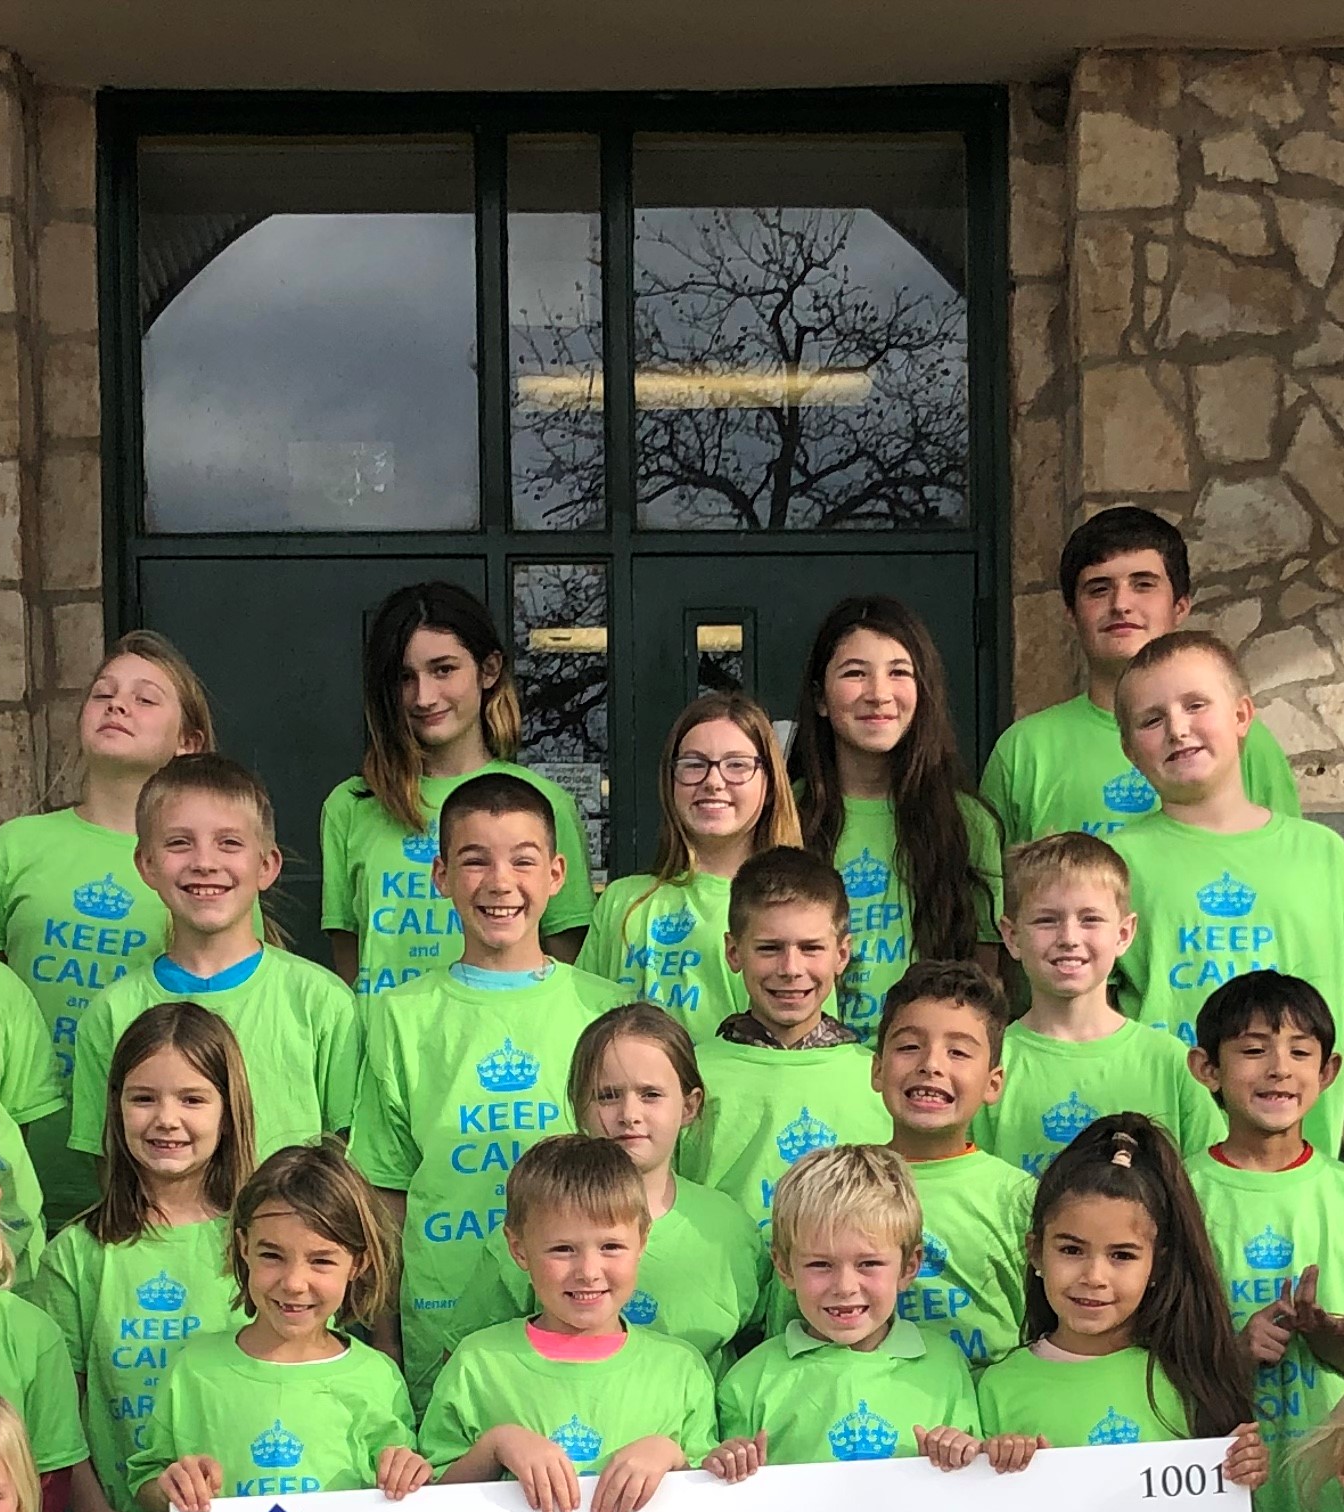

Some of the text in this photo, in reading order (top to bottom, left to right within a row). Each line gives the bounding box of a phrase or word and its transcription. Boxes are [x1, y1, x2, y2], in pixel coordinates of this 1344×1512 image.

[44, 918, 147, 957] KEEP
[409, 942, 440, 957] and
[1178, 926, 1274, 953] KEEP
[66, 995, 90, 1008] an
[459, 1101, 560, 1134] KEEP
[897, 1288, 971, 1322] EEP
[120, 1316, 201, 1341] KEEP
[1140, 1463, 1228, 1499] 1001
